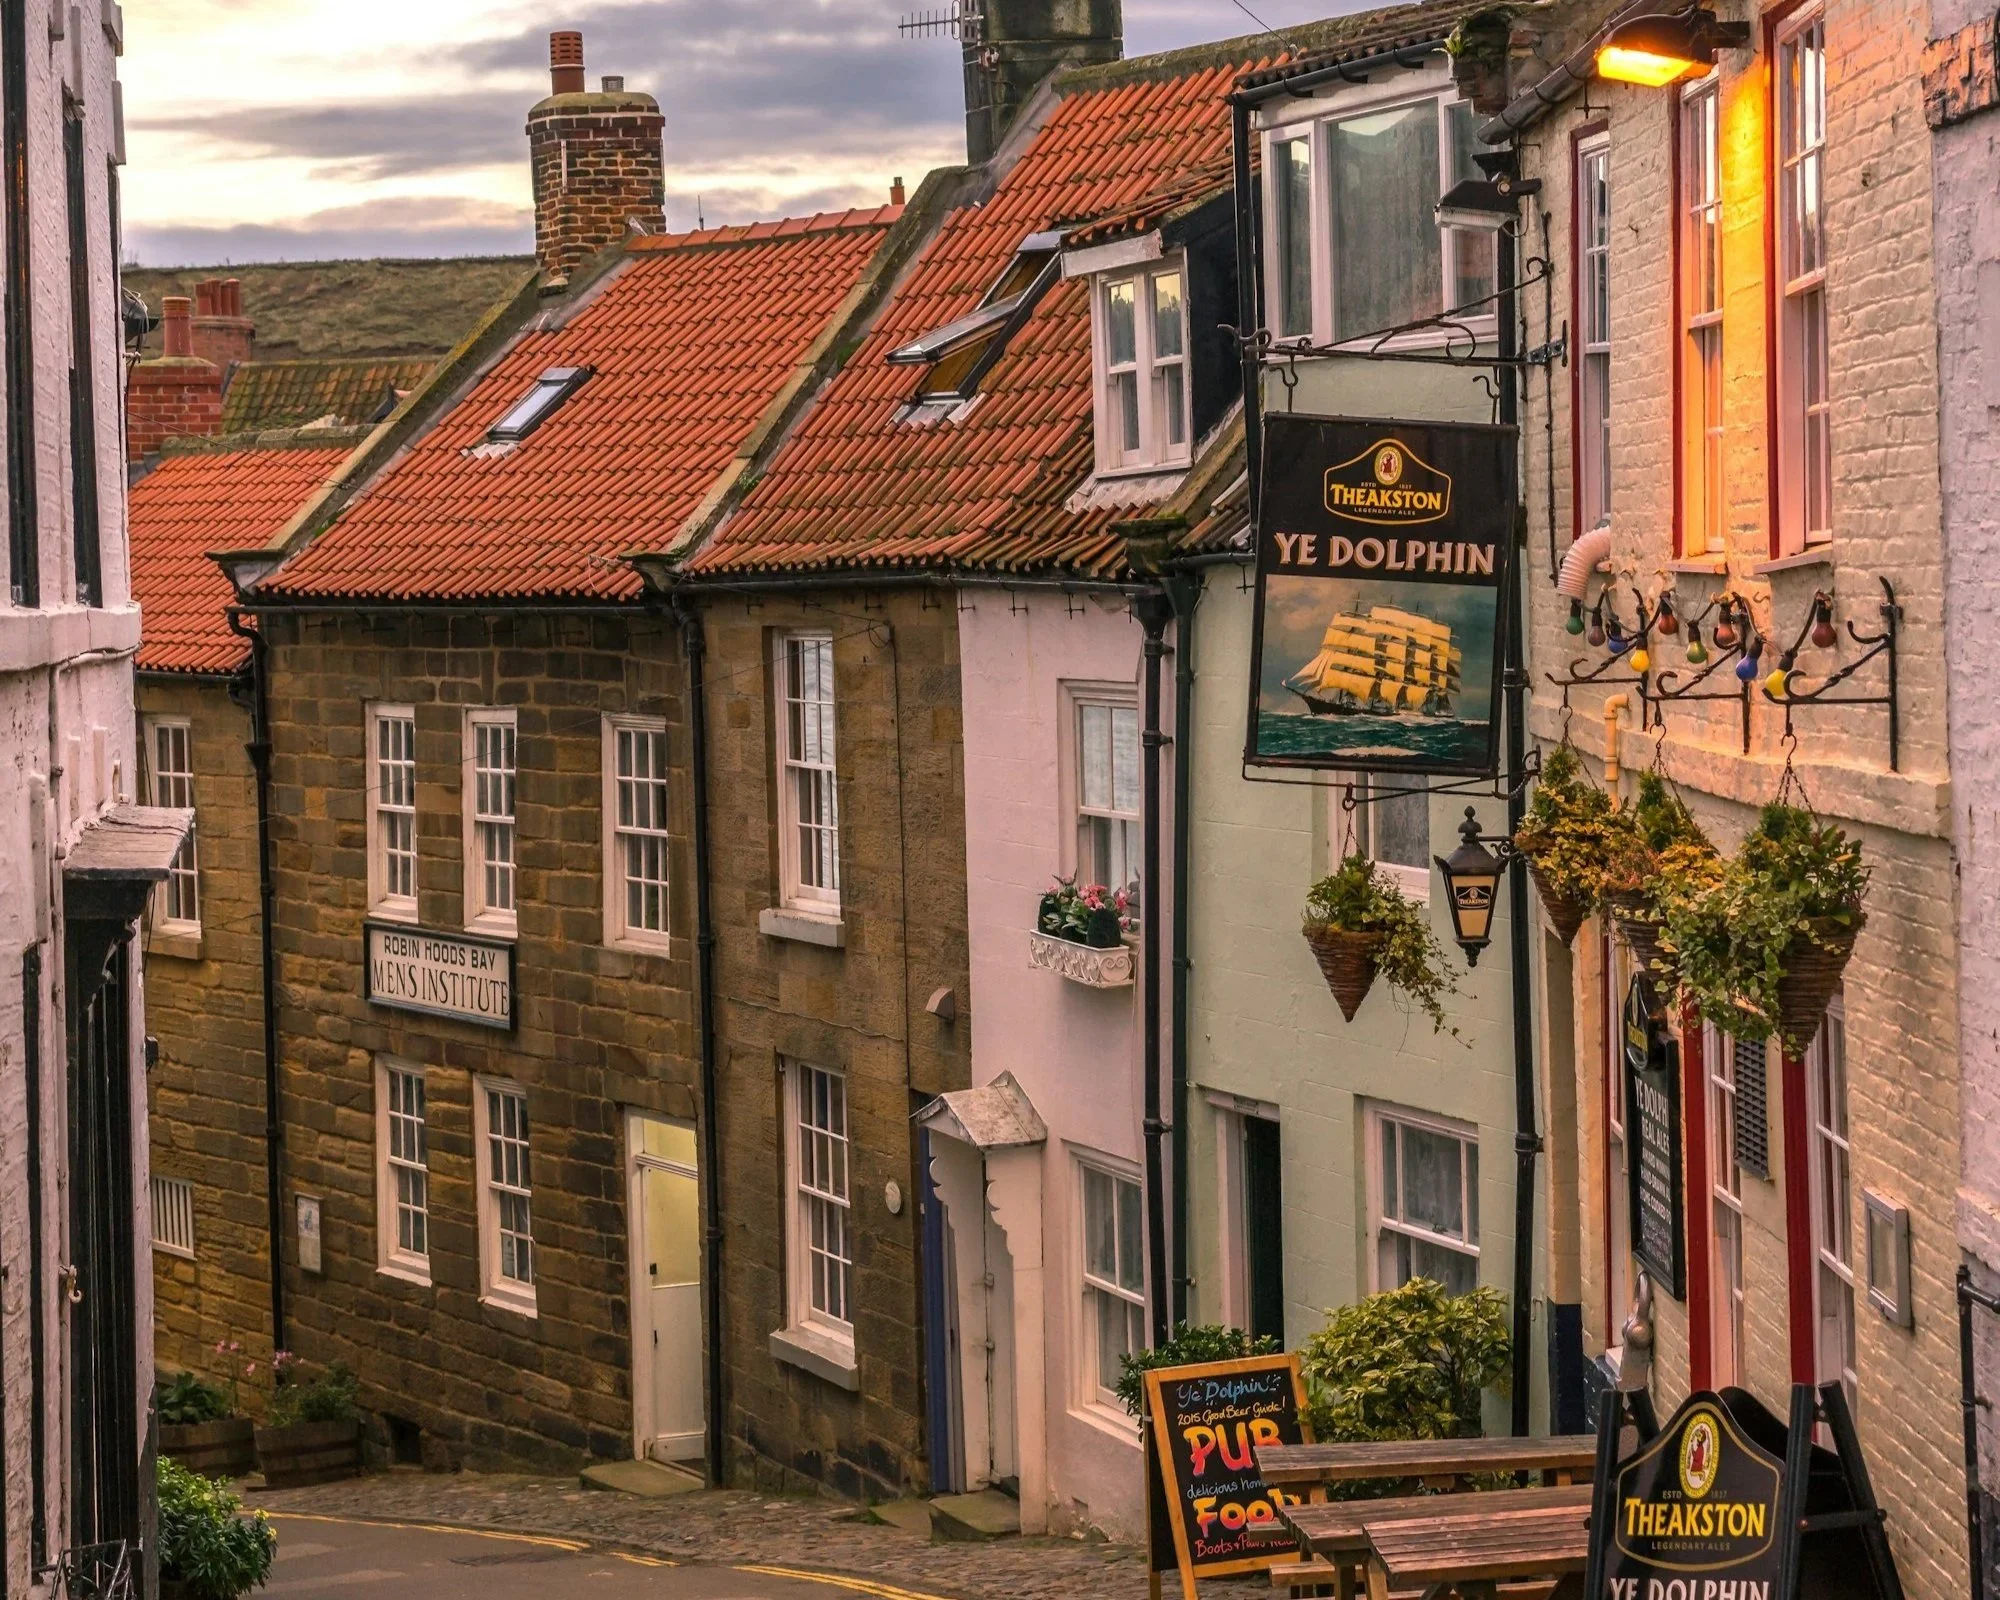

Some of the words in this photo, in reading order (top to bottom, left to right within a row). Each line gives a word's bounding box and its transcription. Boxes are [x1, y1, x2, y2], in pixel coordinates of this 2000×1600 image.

[1330, 483, 1442, 511] THEAKSTON
[1354, 507, 1397, 515] LEGENDARY
[1274, 532, 1317, 566] YE
[1328, 535, 1495, 575] DOLPHIN
[384, 935, 420, 959] ROBIN
[425, 941, 466, 967] HOOD'S
[471, 949, 496, 971] BAY
[373, 959, 417, 998] MEN'S
[421, 967, 509, 1017] INSTITUTE
[1634, 1075, 1644, 1110] YE
[1644, 1082, 1669, 1129] DOLPHI
[1641, 1115, 1656, 1146] REAL
[1656, 1127, 1670, 1157] ALES
[1176, 1383, 1203, 1408] Ye
[1204, 1376, 1269, 1405] Dolphin
[1177, 1412, 1201, 1426] 2015
[1202, 1409, 1226, 1426] Good
[1225, 1404, 1251, 1419] Beer
[1252, 1395, 1286, 1418] Guide!
[1183, 1417, 1283, 1476] PUB
[1187, 1481, 1239, 1499] delicious
[1662, 1490, 1682, 1499] ESTD
[1625, 1496, 1766, 1537] THEAKSTON
[1195, 1538, 1233, 1558] Boots
[1651, 1541, 1705, 1551] LEGENDARY
[1707, 1542, 1731, 1551] ALES
